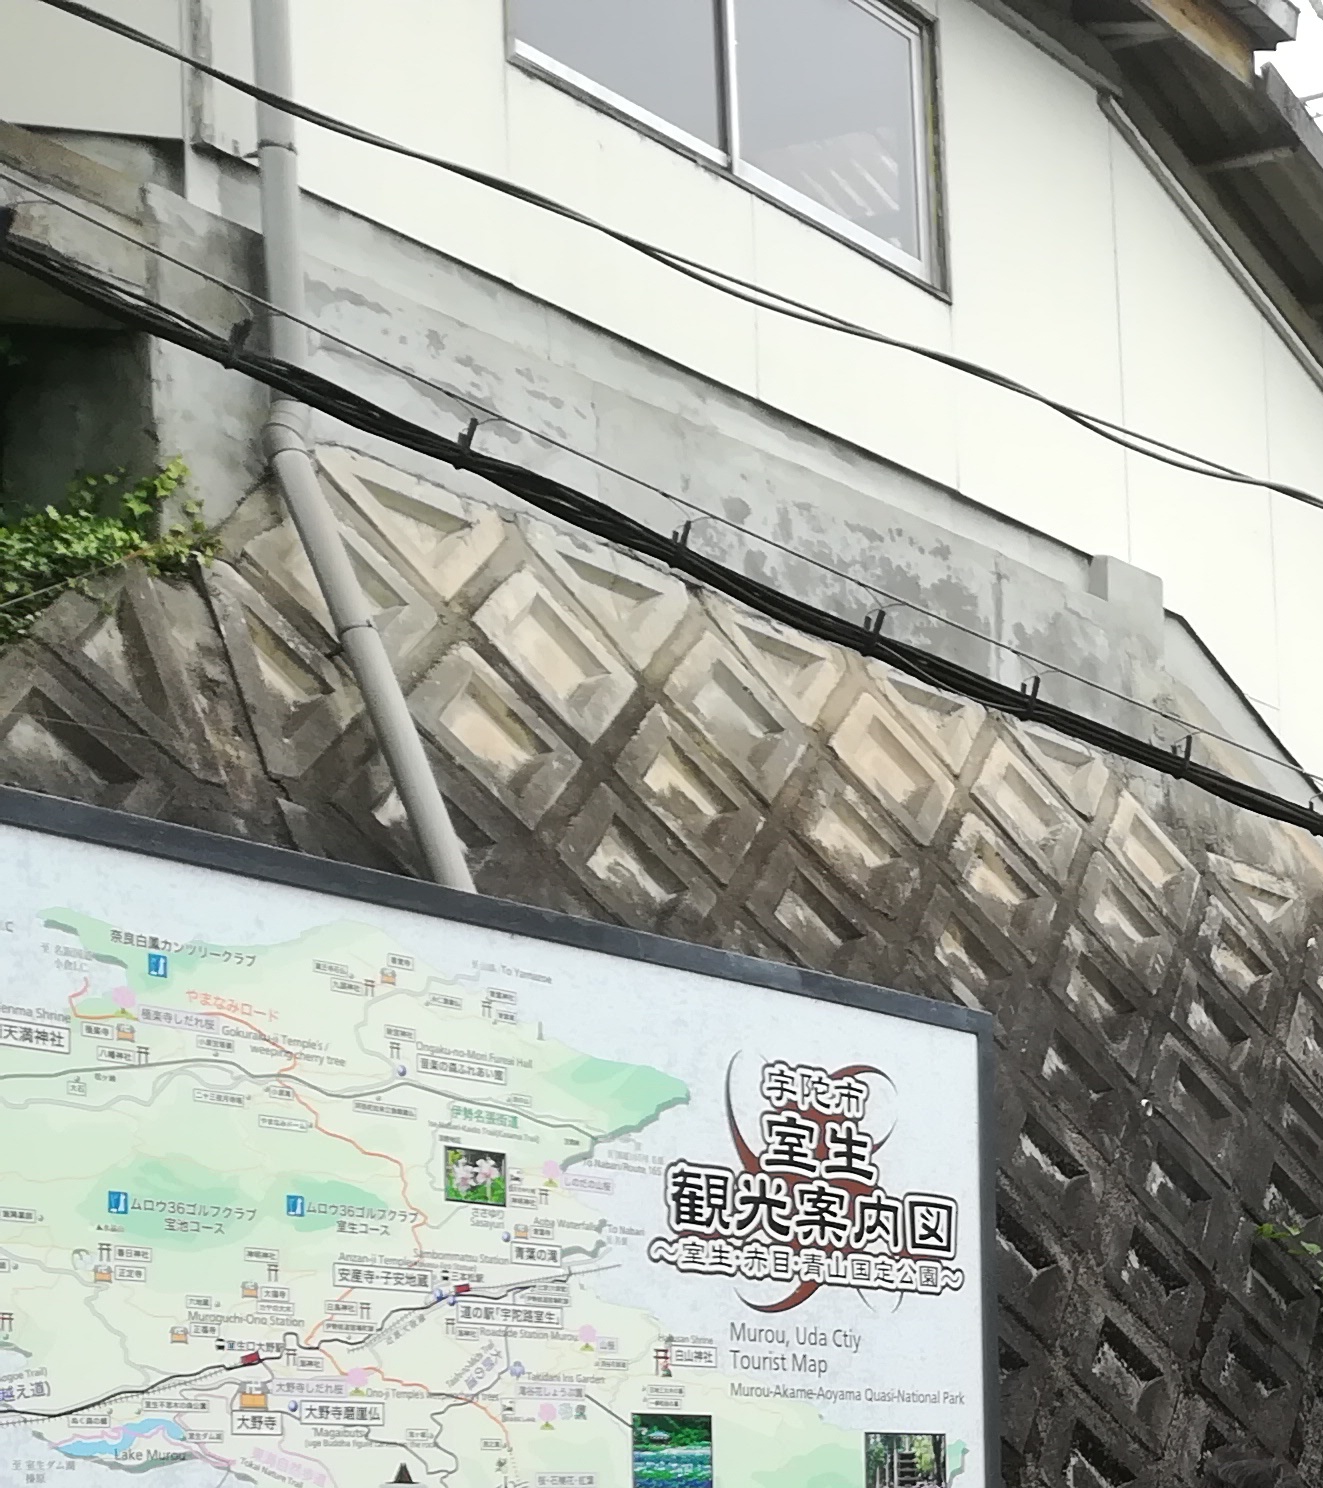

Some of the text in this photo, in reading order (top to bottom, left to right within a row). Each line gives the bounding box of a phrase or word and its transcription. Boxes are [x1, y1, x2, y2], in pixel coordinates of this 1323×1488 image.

[186, 990, 278, 1021] やまなみロード
[0, 1023, 65, 1048] 天満神社
[766, 1068, 866, 1115] 宇陀市
[767, 1115, 874, 1180] 室生
[131, 1199, 257, 1221] ムロウ36ゴルフクラブ
[307, 1203, 419, 1223] ムロウ36ゴルフクラブ
[673, 1169, 954, 1254] 観光案内図
[164, 1218, 225, 1234] 宝池コース
[336, 1220, 390, 1236] 室生コース
[515, 1246, 558, 1263] 青葉の滝
[269, 1314, 304, 1327] Station
[460, 1305, 561, 1325] 道の駅「宇陀路室生」
[729, 1322, 790, 1347] Murou,
[796, 1327, 827, 1347] Uda
[729, 1350, 828, 1377] Tourist Map
[943, 1392, 965, 1405] Park
[237, 1415, 277, 1430] 大野寺
[114, 1450, 143, 1462] Lake
